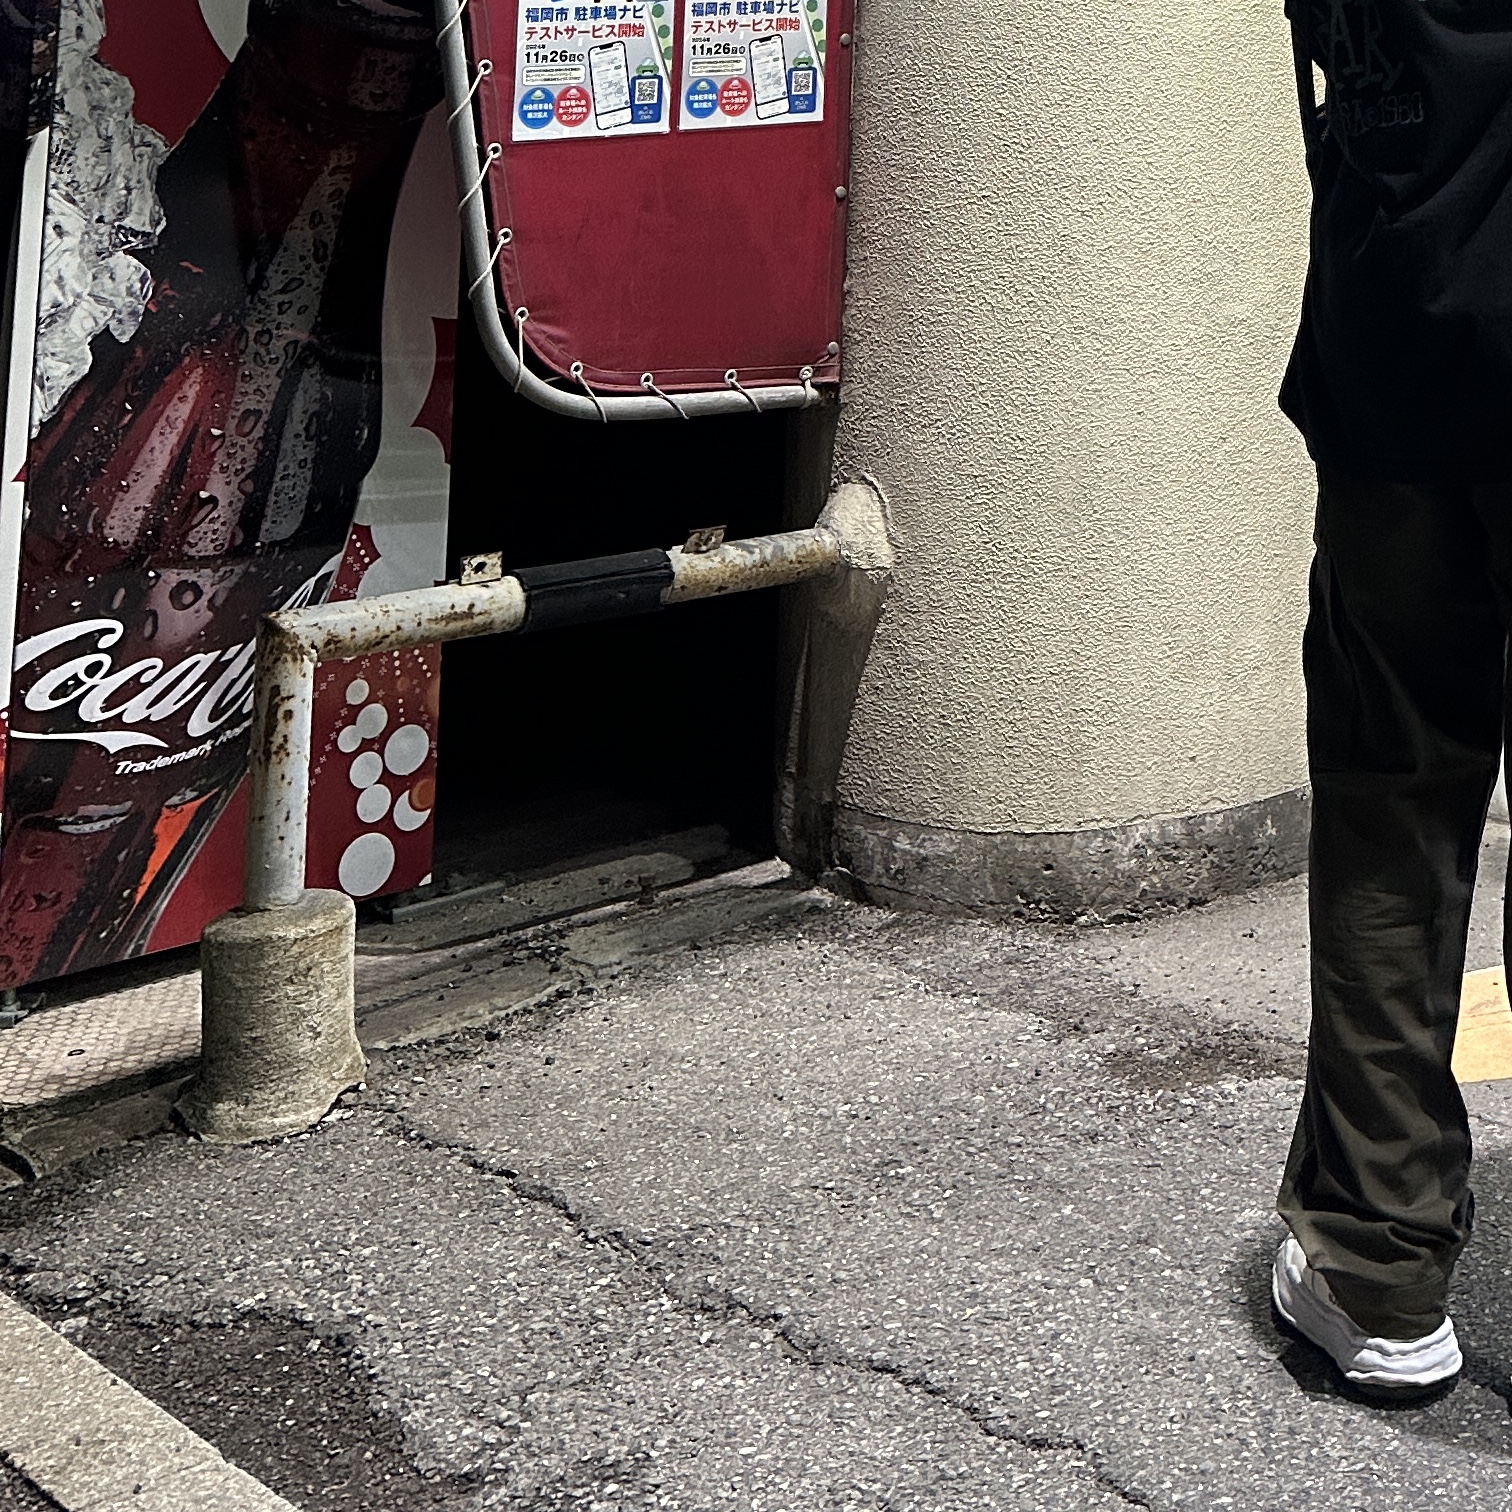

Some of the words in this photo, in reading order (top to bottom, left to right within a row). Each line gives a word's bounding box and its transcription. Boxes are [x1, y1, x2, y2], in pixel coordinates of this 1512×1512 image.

[525, 7, 569, 23] 福岡市
[574, 4, 646, 21] 駐車場ナビ
[691, 2, 731, 17] 福岡市
[736, 0, 801, 15] 駐車場ナビ
[525, 23, 646, 41] テストサービス開始
[691, 17, 801, 34] テストサービス開始
